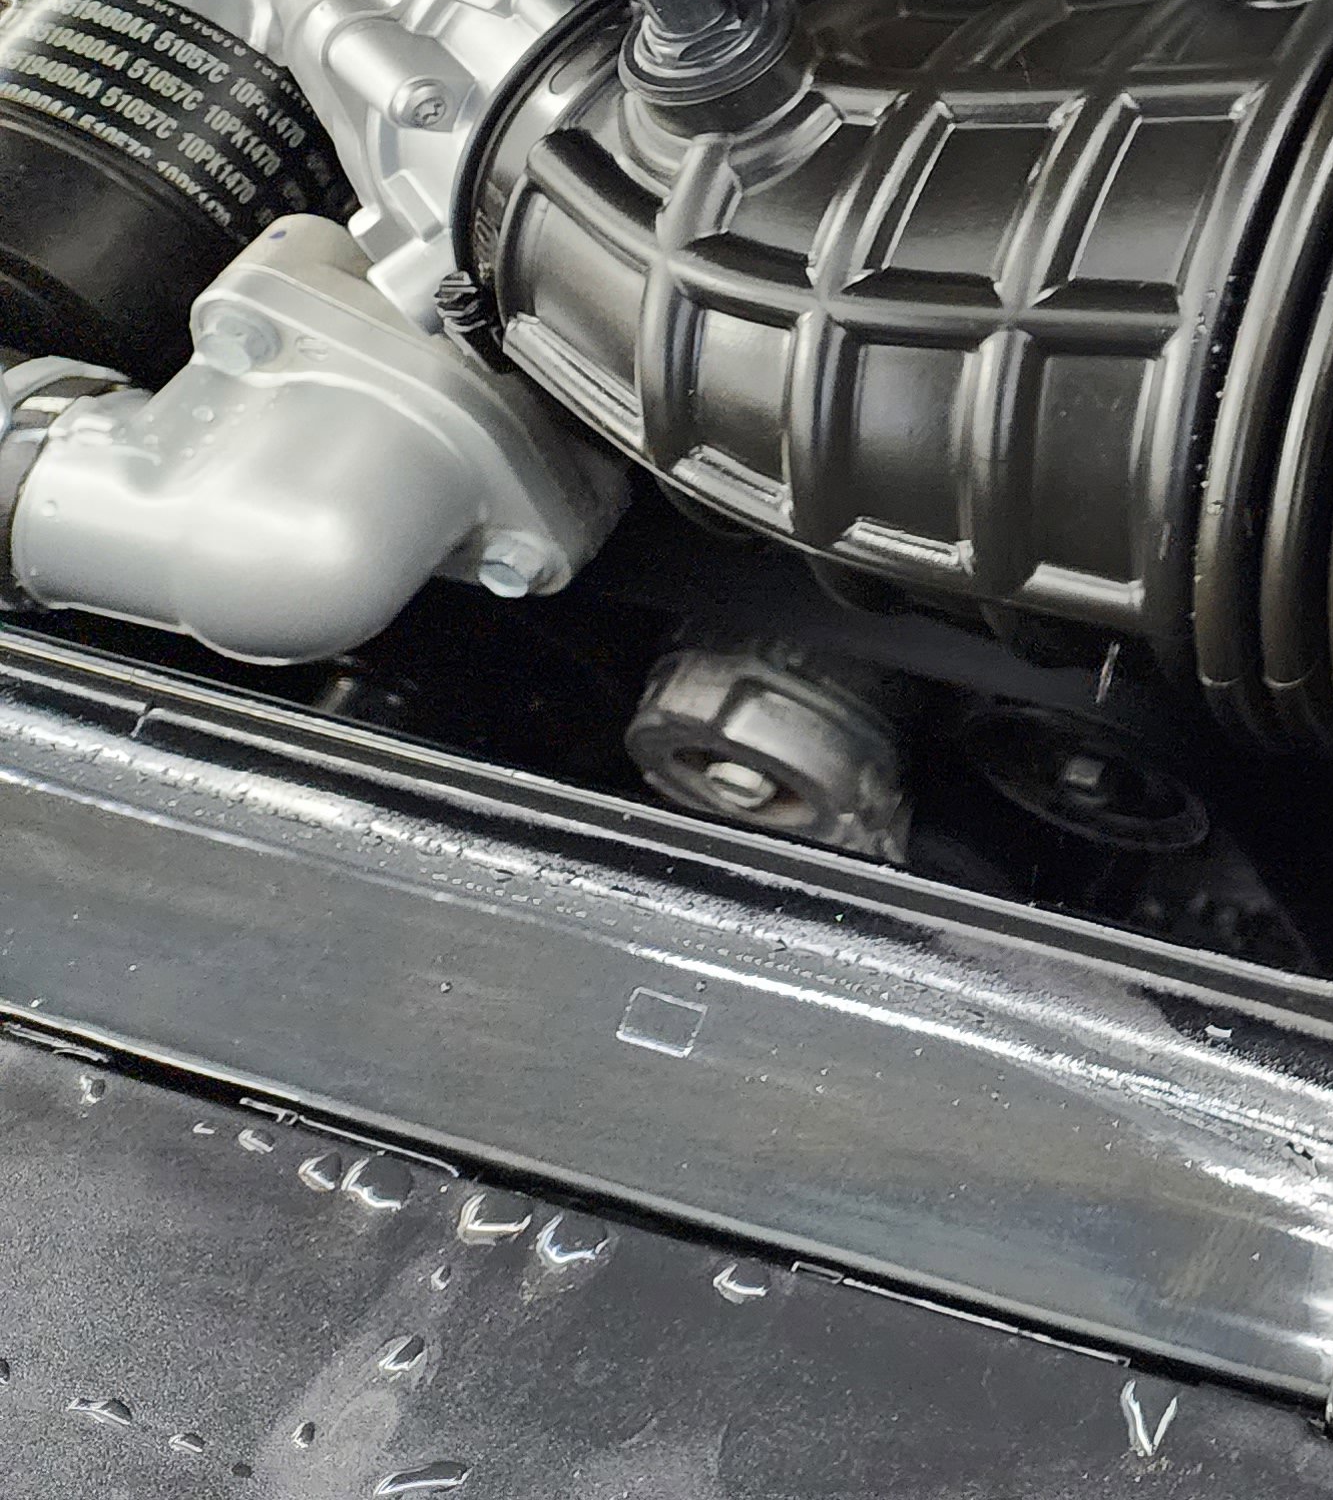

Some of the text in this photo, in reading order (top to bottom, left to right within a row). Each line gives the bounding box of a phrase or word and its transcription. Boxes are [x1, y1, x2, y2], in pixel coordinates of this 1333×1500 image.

[127, 57, 204, 112] 51057C
[203, 104, 281, 177] 10PK1470
[153, 31, 231, 84] 51057C
[100, 86, 179, 140] 51057C
[177, 132, 257, 205] 10PK1470
